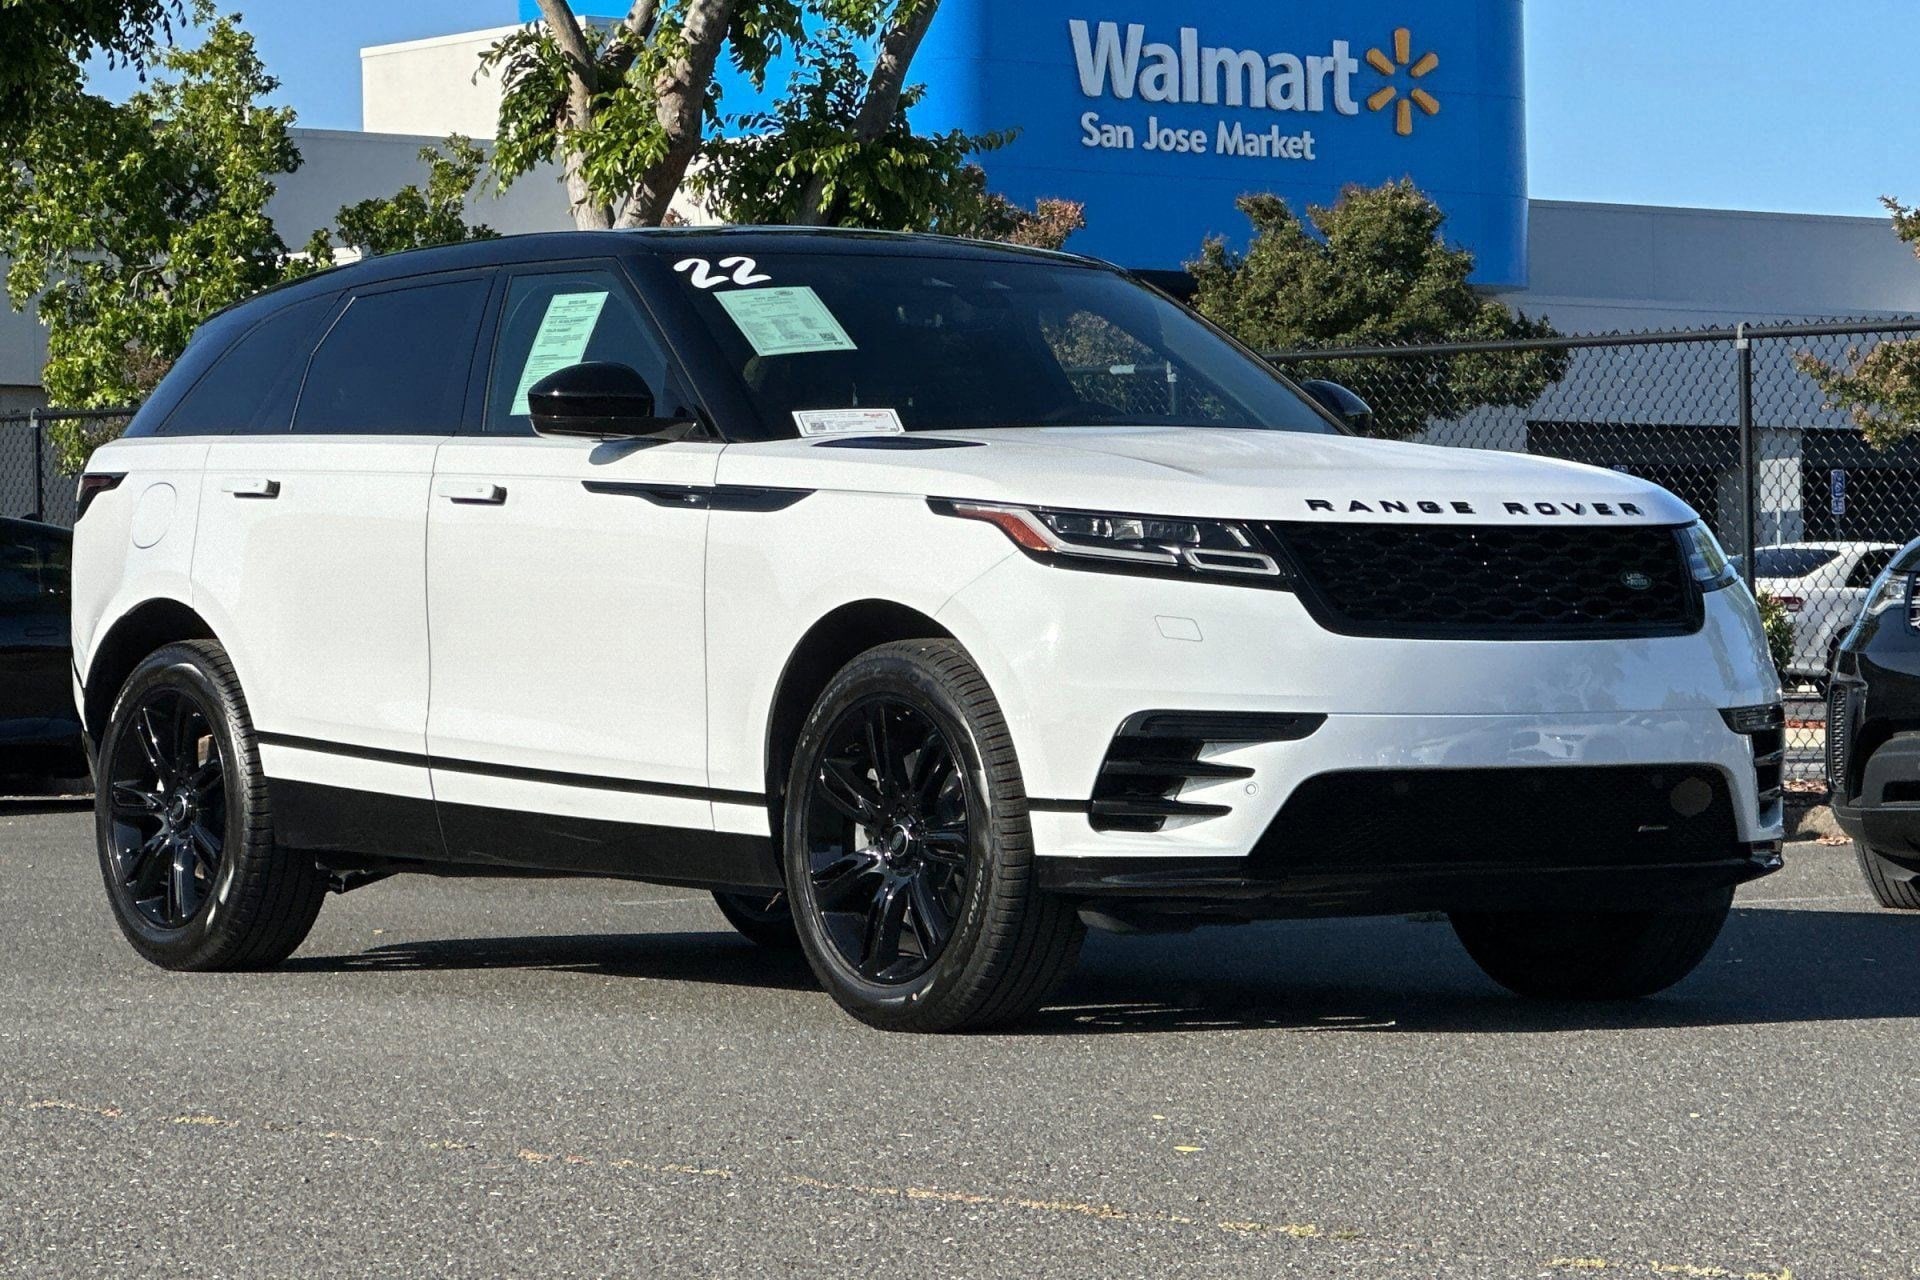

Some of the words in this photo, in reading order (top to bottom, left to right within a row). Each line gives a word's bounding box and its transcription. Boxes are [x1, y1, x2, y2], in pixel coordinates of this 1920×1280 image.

[1069, 19, 1358, 115] Walmart
[1081, 111, 1134, 149] San
[1142, 117, 1207, 153] Jose
[1216, 120, 1316, 160] Market
[673, 256, 772, 288] 22
[1304, 499, 1477, 514] RANGE
[1502, 502, 1645, 516] ROVER
